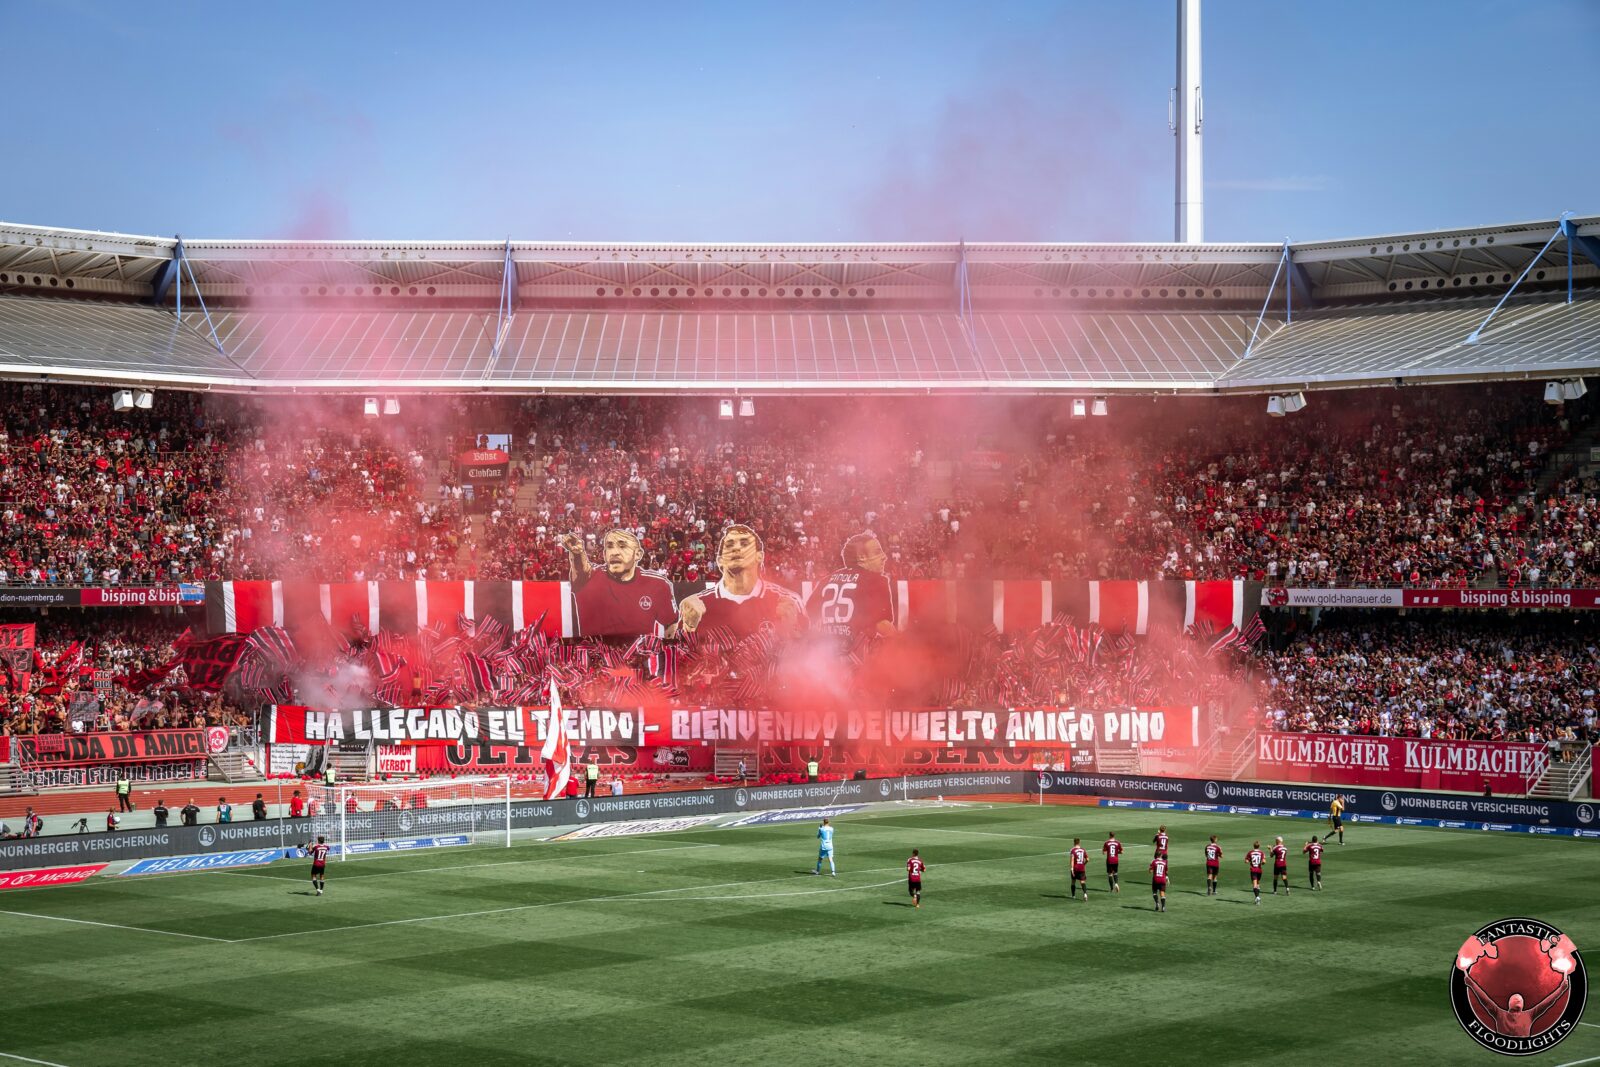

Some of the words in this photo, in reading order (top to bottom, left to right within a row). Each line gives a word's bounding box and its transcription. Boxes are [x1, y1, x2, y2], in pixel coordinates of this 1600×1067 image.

[101, 589, 146, 604] bisping
[148, 589, 158, 602] &
[822, 583, 857, 624] 25
[1293, 594, 1392, 605] www.gold-hanauer.de
[1460, 590, 1508, 606] bisping
[1510, 591, 1520, 603] &
[1522, 591, 1571, 606] bisping
[305, 710, 345, 740] HA
[353, 709, 479, 740] LLEGADO
[488, 711, 524, 740] EL
[672, 709, 837, 740] BIENVENIDO
[848, 711, 881, 740] DE
[892, 710, 997, 741] VUELTO
[1006, 711, 1095, 742] AMIGO
[1104, 712, 1165, 742] PINO
[112, 736, 138, 758] DI
[144, 732, 206, 756] AMICI
[1258, 734, 1390, 767] KULMBACHER
[379, 759, 411, 771] VERBOT
[1404, 741, 1548, 774] KULMBACHER
[894, 778, 942, 791] NÜRNBERGER
[944, 775, 1011, 787] VERSICHERUNG
[1057, 776, 1116, 788] NÜRNBERGER
[1118, 780, 1183, 793] VERSICHERUNG
[751, 787, 803, 801] NÜRNBERGER
[805, 785, 861, 797] VERSICHERUNG
[1222, 786, 1283, 799] NÜRNBERGER
[593, 798, 651, 812] NÜRNBERGER
[652, 795, 715, 808] VERSICHERUNG
[1401, 797, 1468, 811] NÜRNBERGER
[1471, 801, 1549, 816] VERSICHERUNG
[418, 810, 482, 824] NÜRNBERGER
[221, 823, 292, 840] NÜRNBERGER
[0, 841, 79, 858] NÜRNBERGER
[82, 834, 169, 850] VERSICHERUNG
[1110, 845, 1116, 855] 6
[1313, 848, 1319, 859] 3
[141, 850, 276, 873] HELMSAUER
[317, 851, 325, 860] 17
[1251, 854, 1262, 865] 20
[1281, 850, 1286, 859] 7
[913, 863, 919, 873] 2
[1156, 864, 1165, 876] 10
